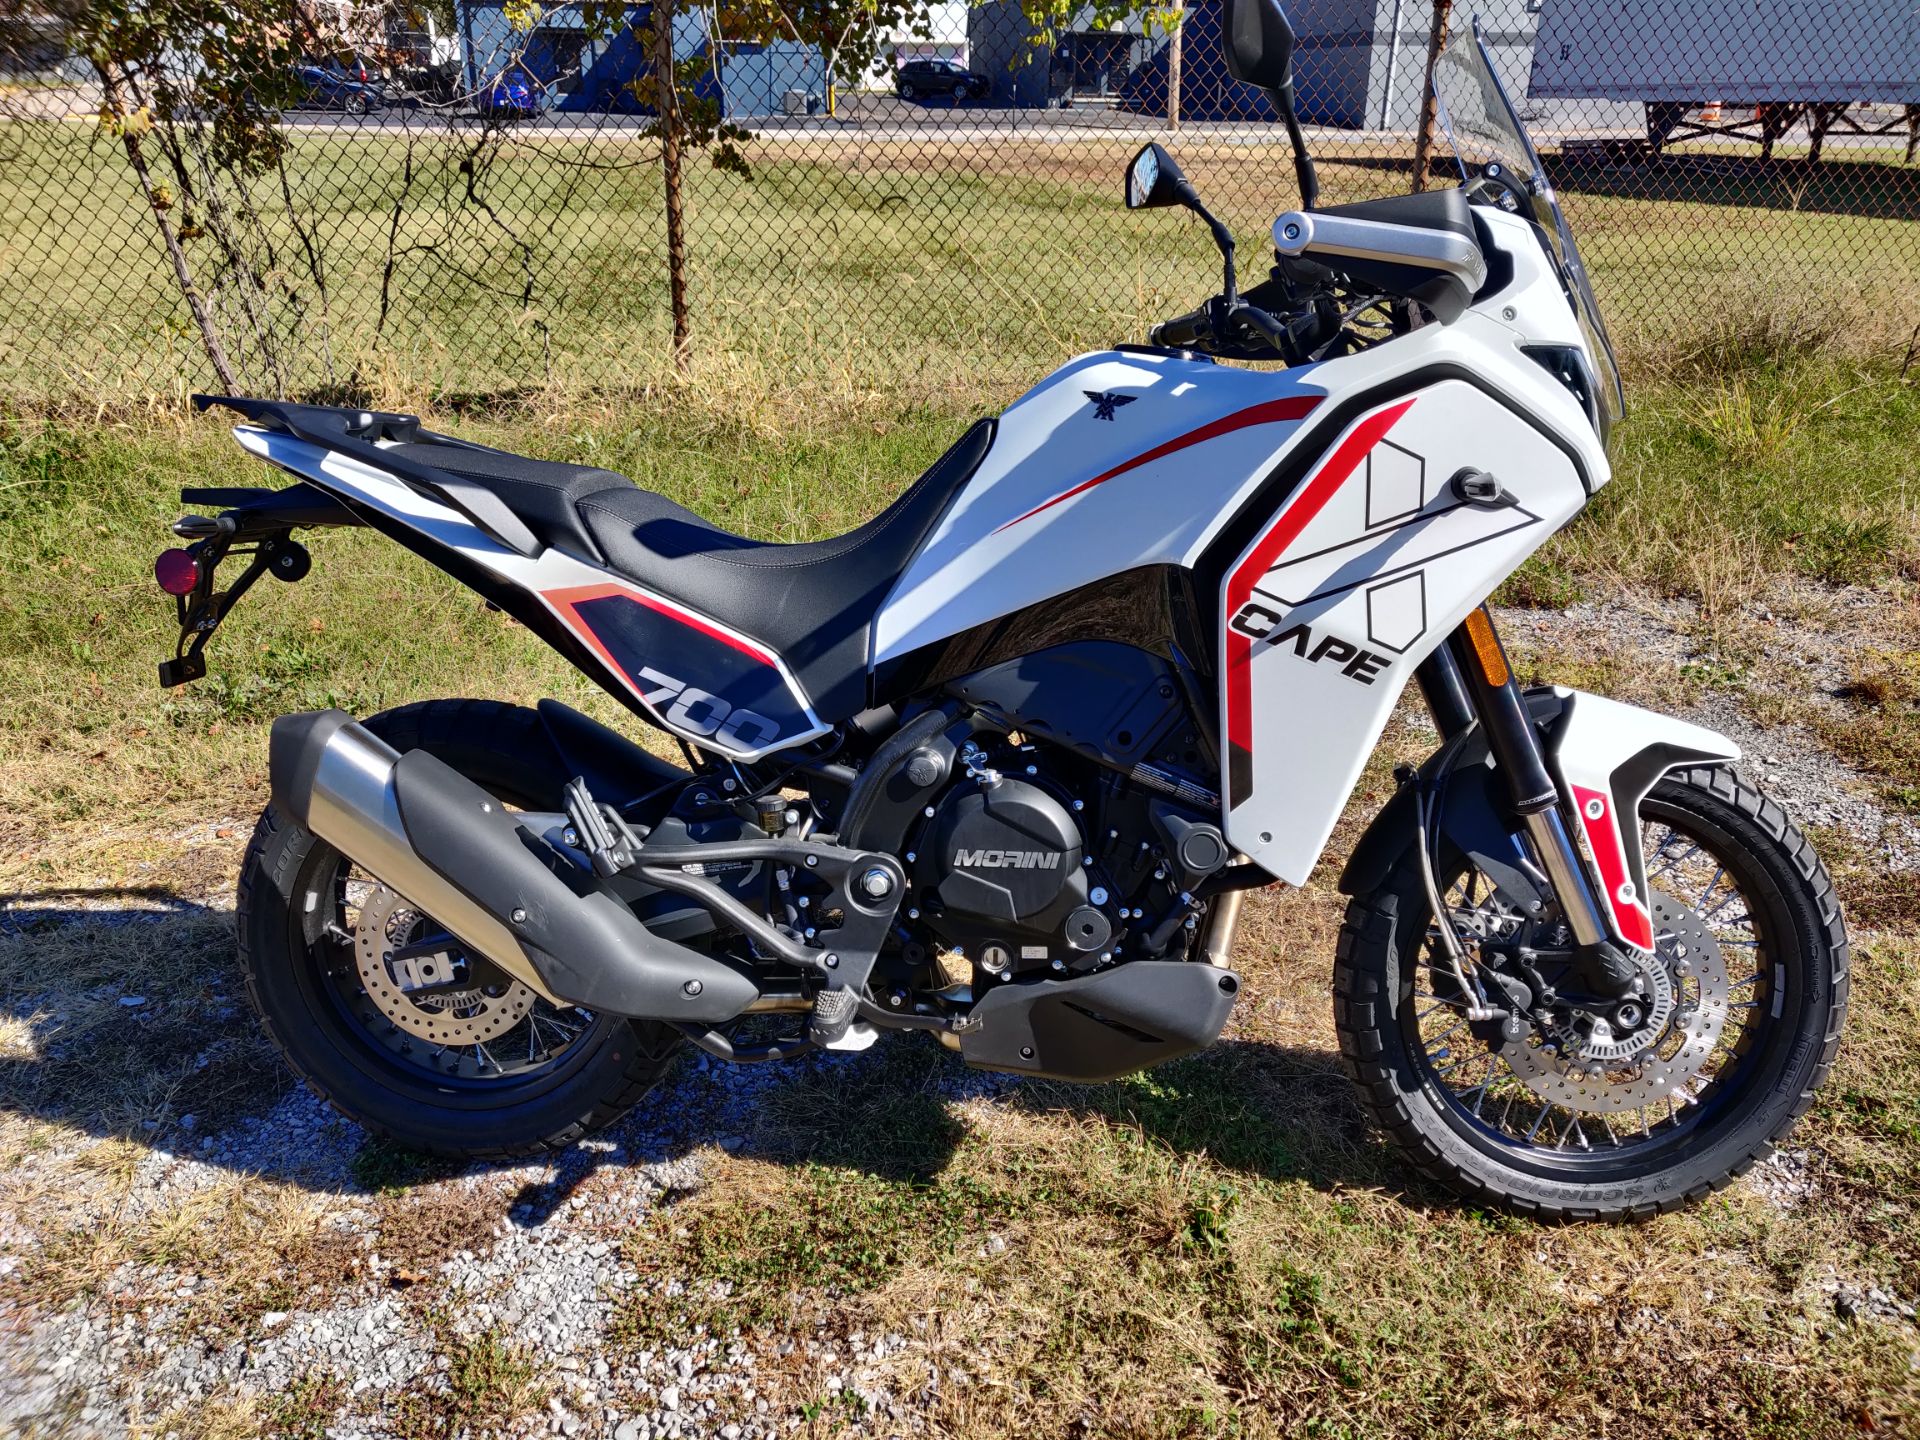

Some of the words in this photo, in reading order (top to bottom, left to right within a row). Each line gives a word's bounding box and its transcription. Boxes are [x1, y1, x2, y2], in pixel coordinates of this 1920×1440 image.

[1231, 603, 1392, 686] CAPE
[638, 666, 780, 752] 700
[953, 848, 1061, 870] MORINI
[1510, 994, 1520, 1034] bremo
[1411, 1105, 1483, 1171] RALLY
[1486, 1168, 1643, 1202] SCORPION
